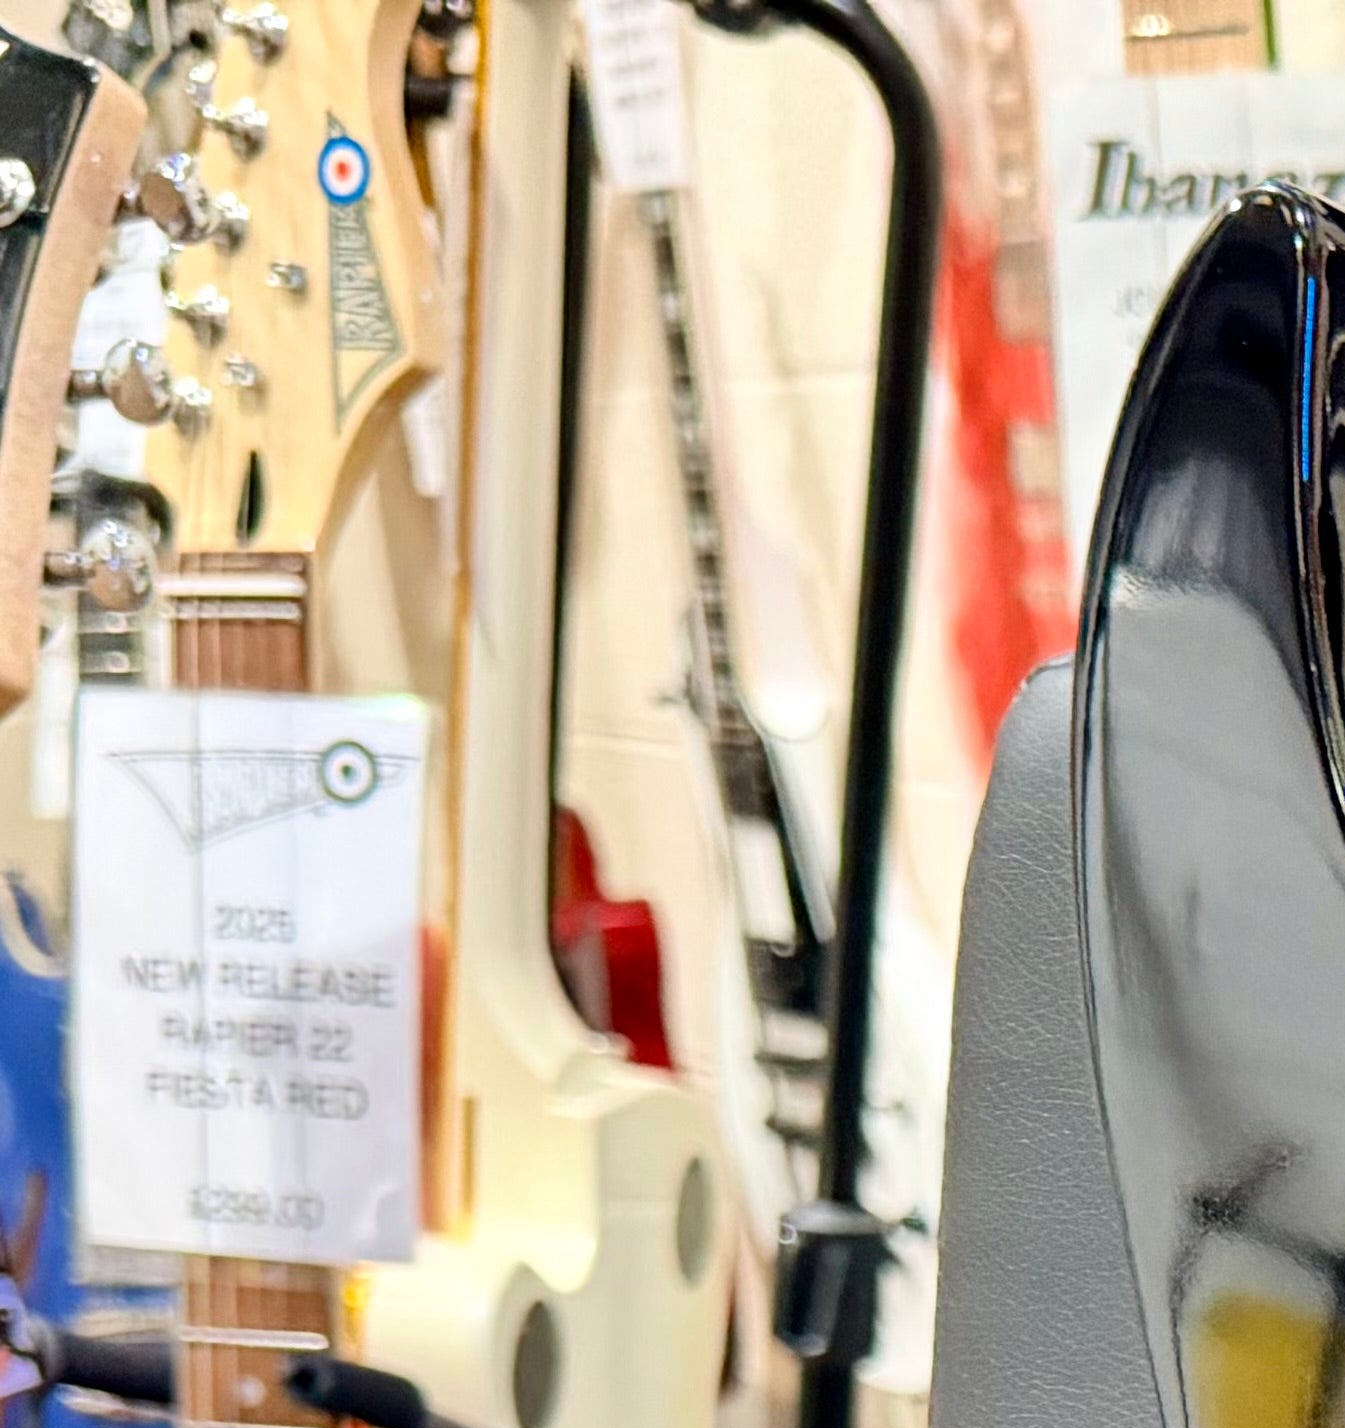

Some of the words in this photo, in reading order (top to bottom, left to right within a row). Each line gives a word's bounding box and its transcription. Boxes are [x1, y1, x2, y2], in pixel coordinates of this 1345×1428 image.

[123, 956, 204, 992] NEW
[221, 963, 394, 1006] RELEASE
[162, 1015, 296, 1057] RAPIER
[309, 1024, 353, 1060] 22
[145, 1069, 279, 1111] FIESTA
[286, 1077, 371, 1121] RED
